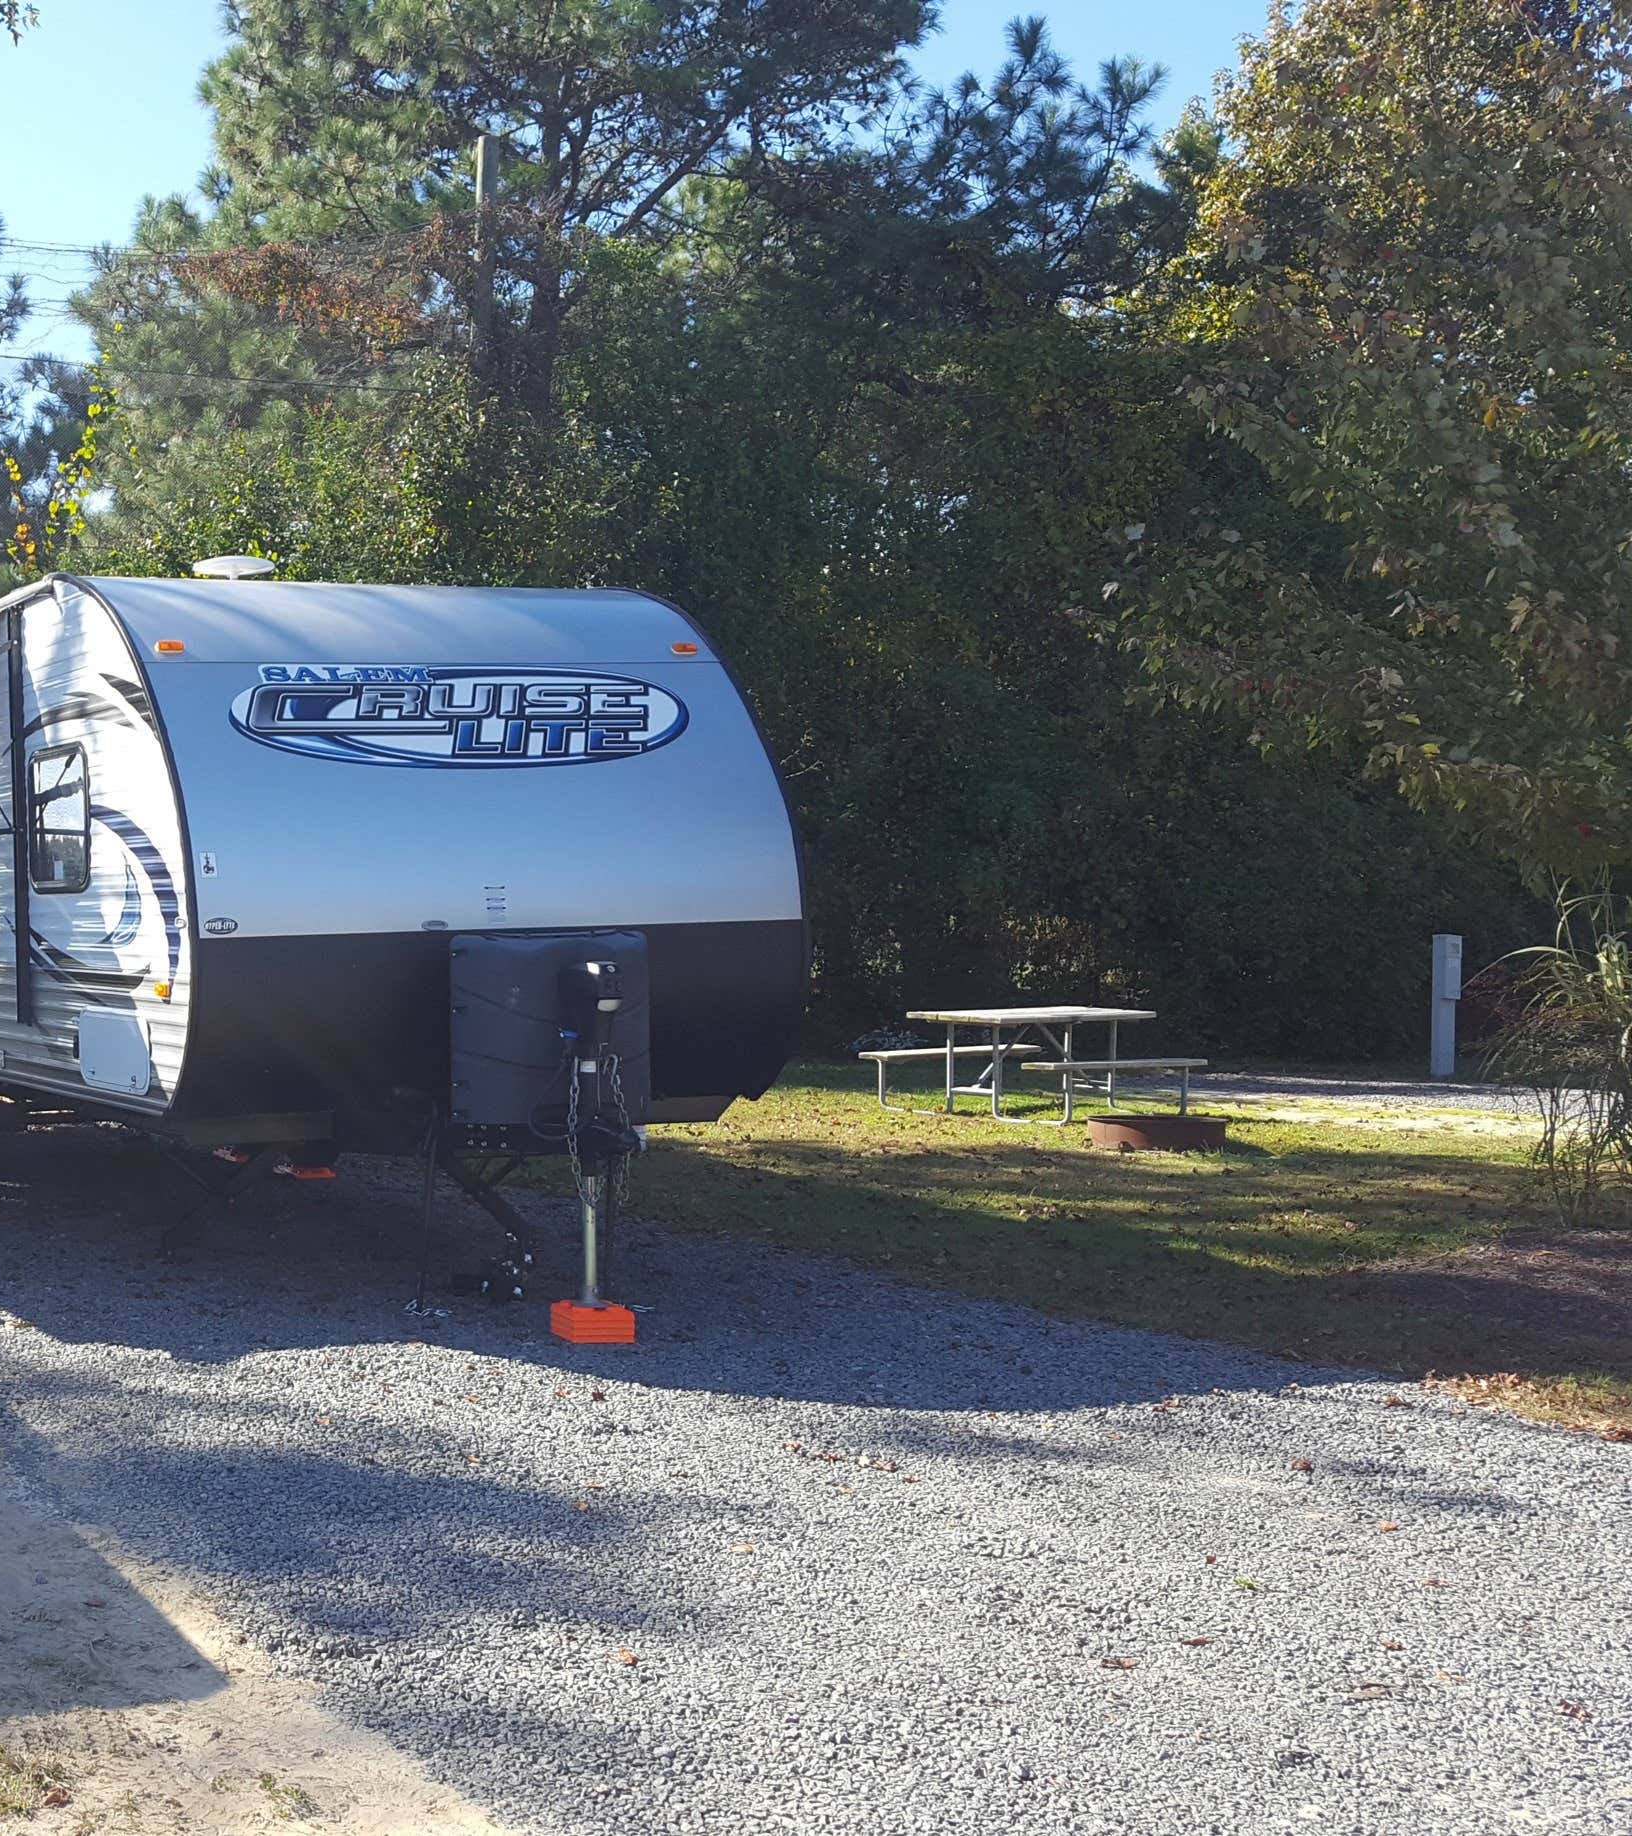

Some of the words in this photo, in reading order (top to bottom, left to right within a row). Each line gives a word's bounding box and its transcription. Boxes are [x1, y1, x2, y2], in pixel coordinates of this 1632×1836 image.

[261, 665, 432, 683] SALEM
[248, 682, 646, 734] CRUISE
[454, 718, 645, 756] LITE
